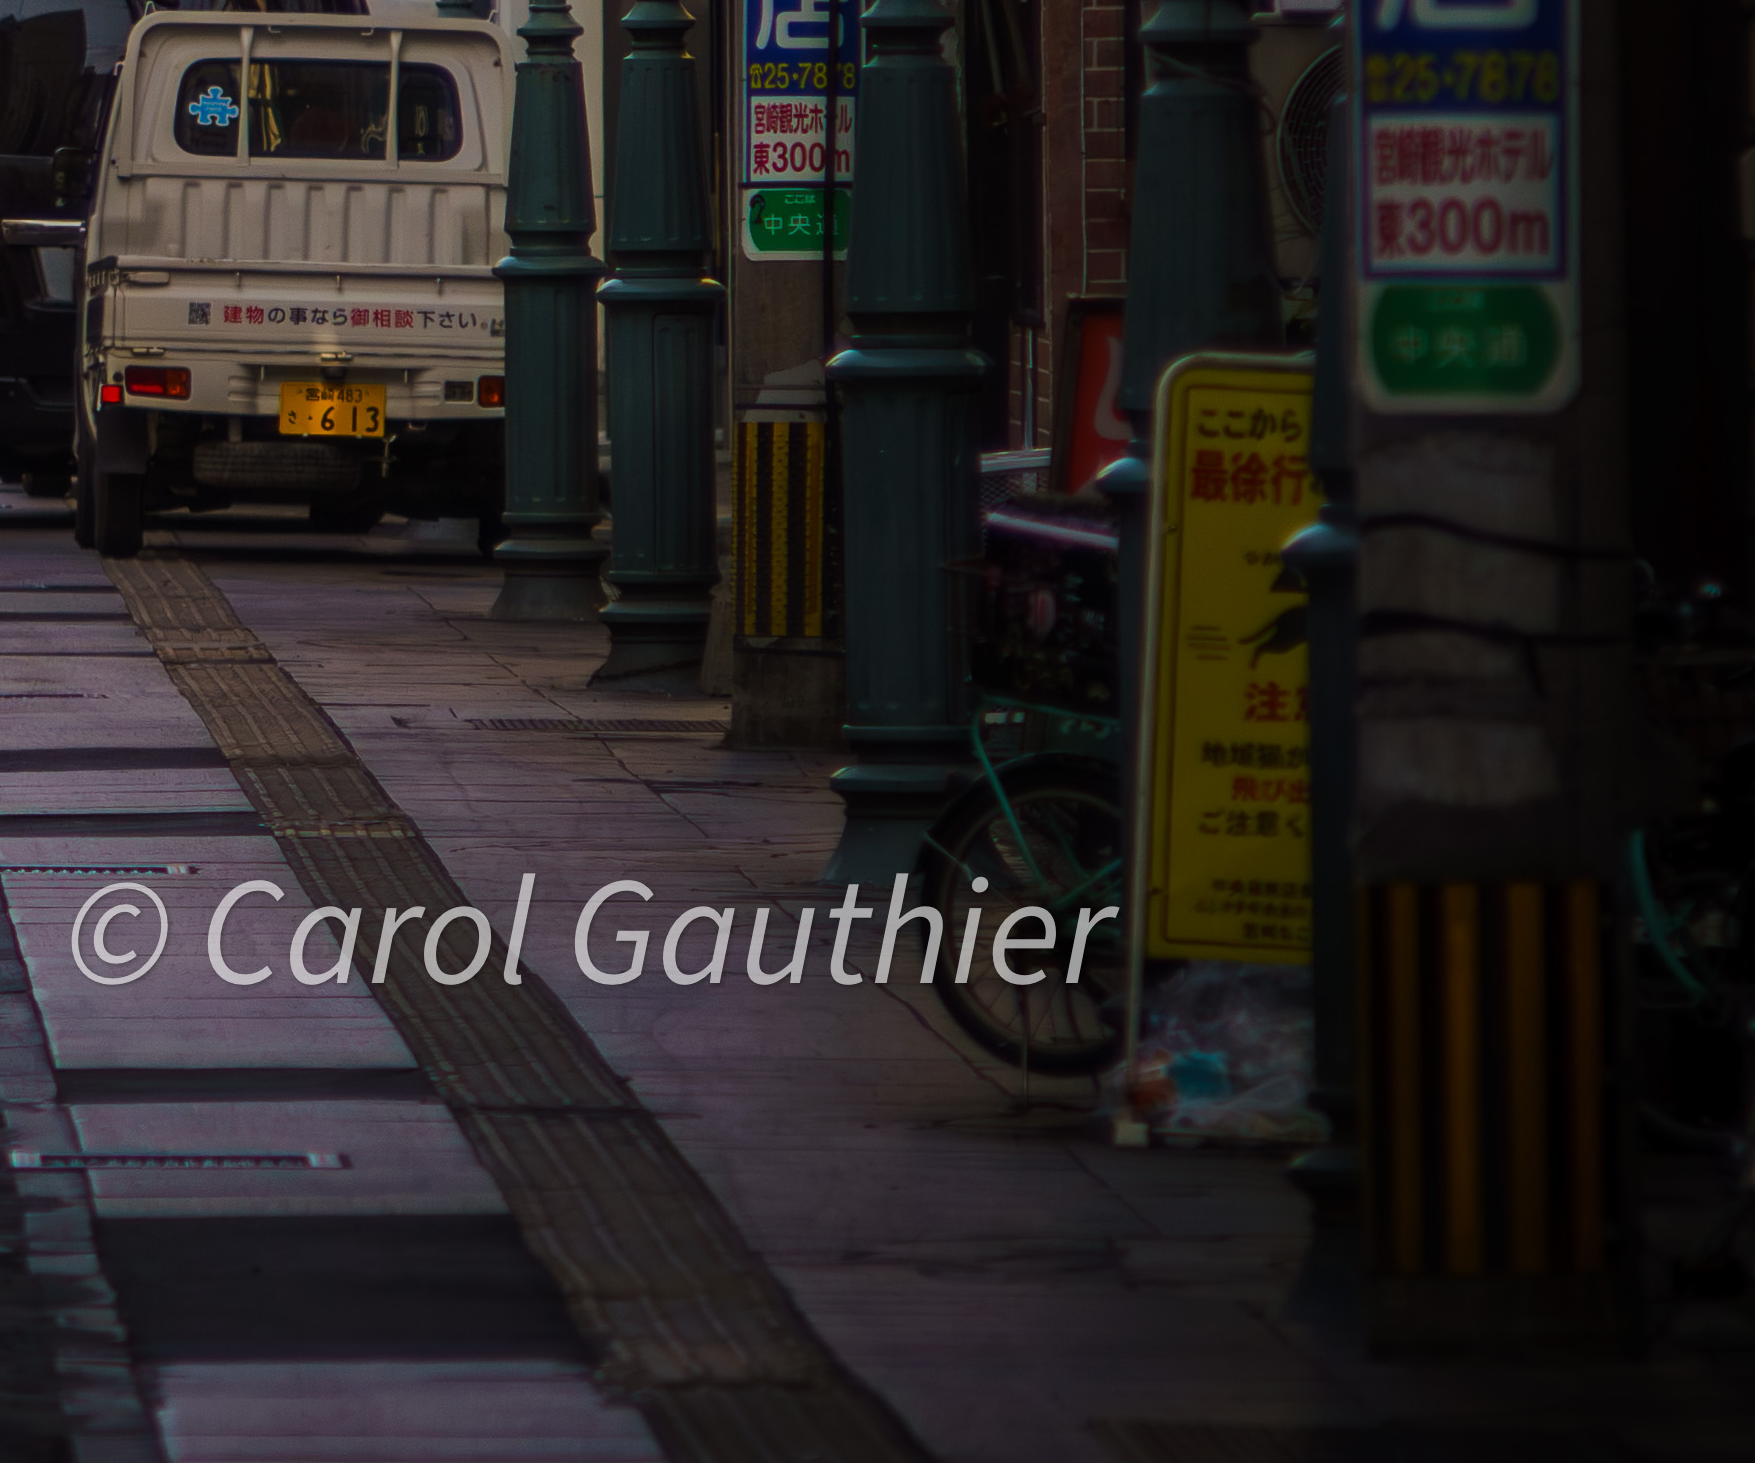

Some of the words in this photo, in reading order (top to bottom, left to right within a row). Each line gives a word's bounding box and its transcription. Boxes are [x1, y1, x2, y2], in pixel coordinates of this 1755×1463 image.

[752, 140, 851, 176] 東300m
[1375, 127, 1554, 187] 宮崎観光ホテル
[1376, 197, 1551, 258] 東300m
[1198, 408, 1303, 441] ここから
